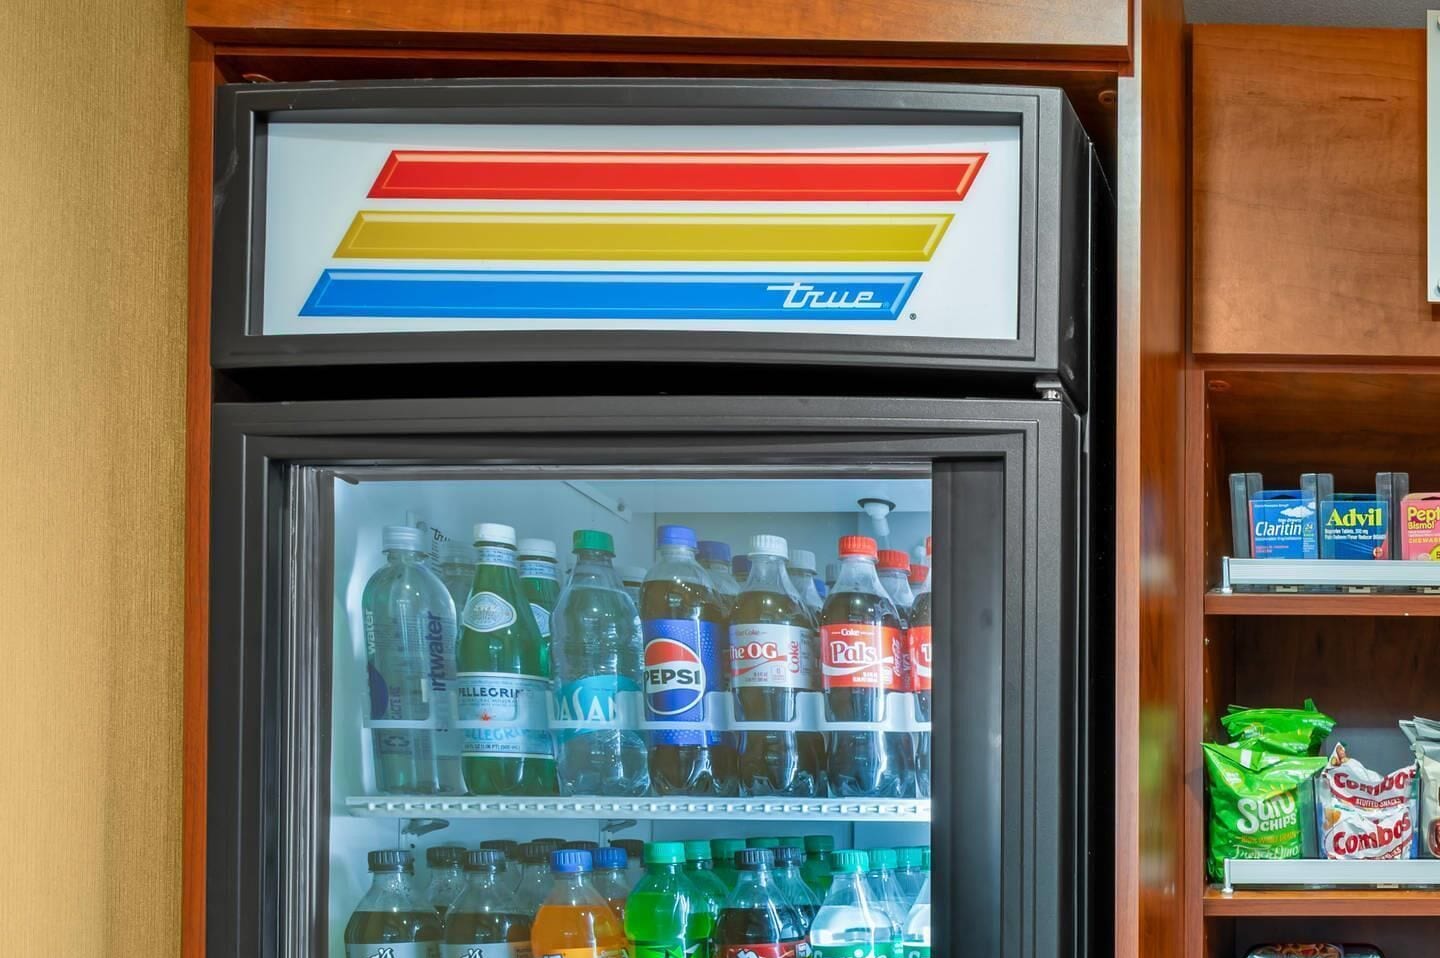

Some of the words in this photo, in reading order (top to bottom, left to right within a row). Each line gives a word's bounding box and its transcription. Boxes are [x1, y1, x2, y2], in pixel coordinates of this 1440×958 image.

[768, 282, 884, 309] true
[1326, 507, 1383, 527] Advil
[1408, 521, 1435, 530] Bismol
[1255, 522, 1303, 537] Claritin
[747, 642, 779, 659] OG
[831, 641, 878, 664] Pals
[644, 669, 702, 685] PEPSI
[1237, 793, 1296, 834] Sun
[1259, 814, 1297, 832] CHIPS
[1333, 812, 1412, 855] Combos
